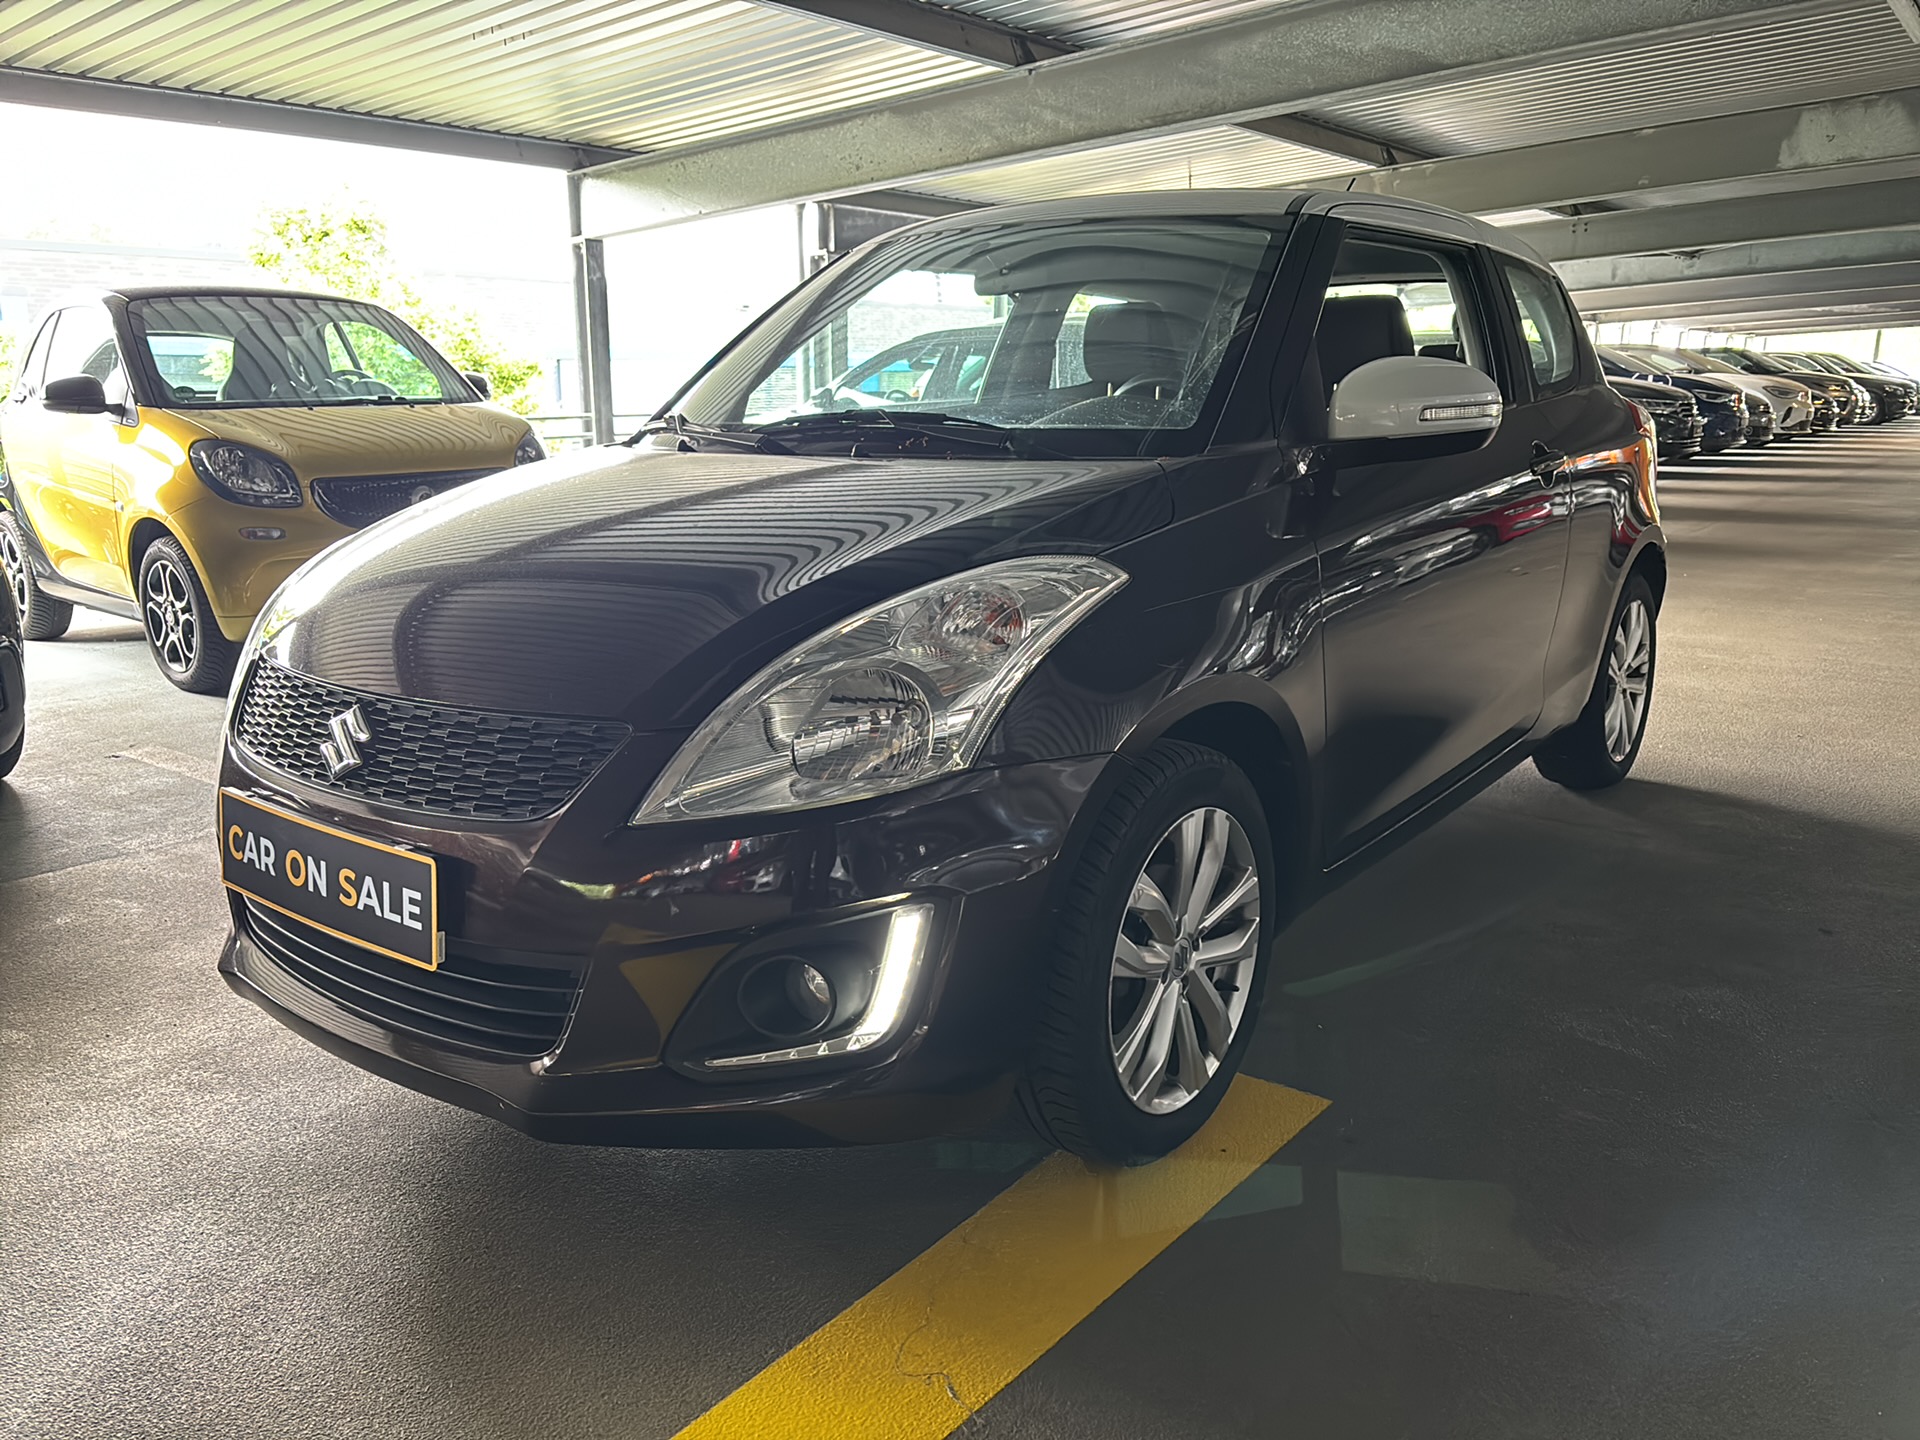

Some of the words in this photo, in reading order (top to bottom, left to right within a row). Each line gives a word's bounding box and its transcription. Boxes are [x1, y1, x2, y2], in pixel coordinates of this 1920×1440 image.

[228, 824, 276, 876] CAR
[285, 849, 327, 898] ON
[338, 868, 423, 931] SALE
